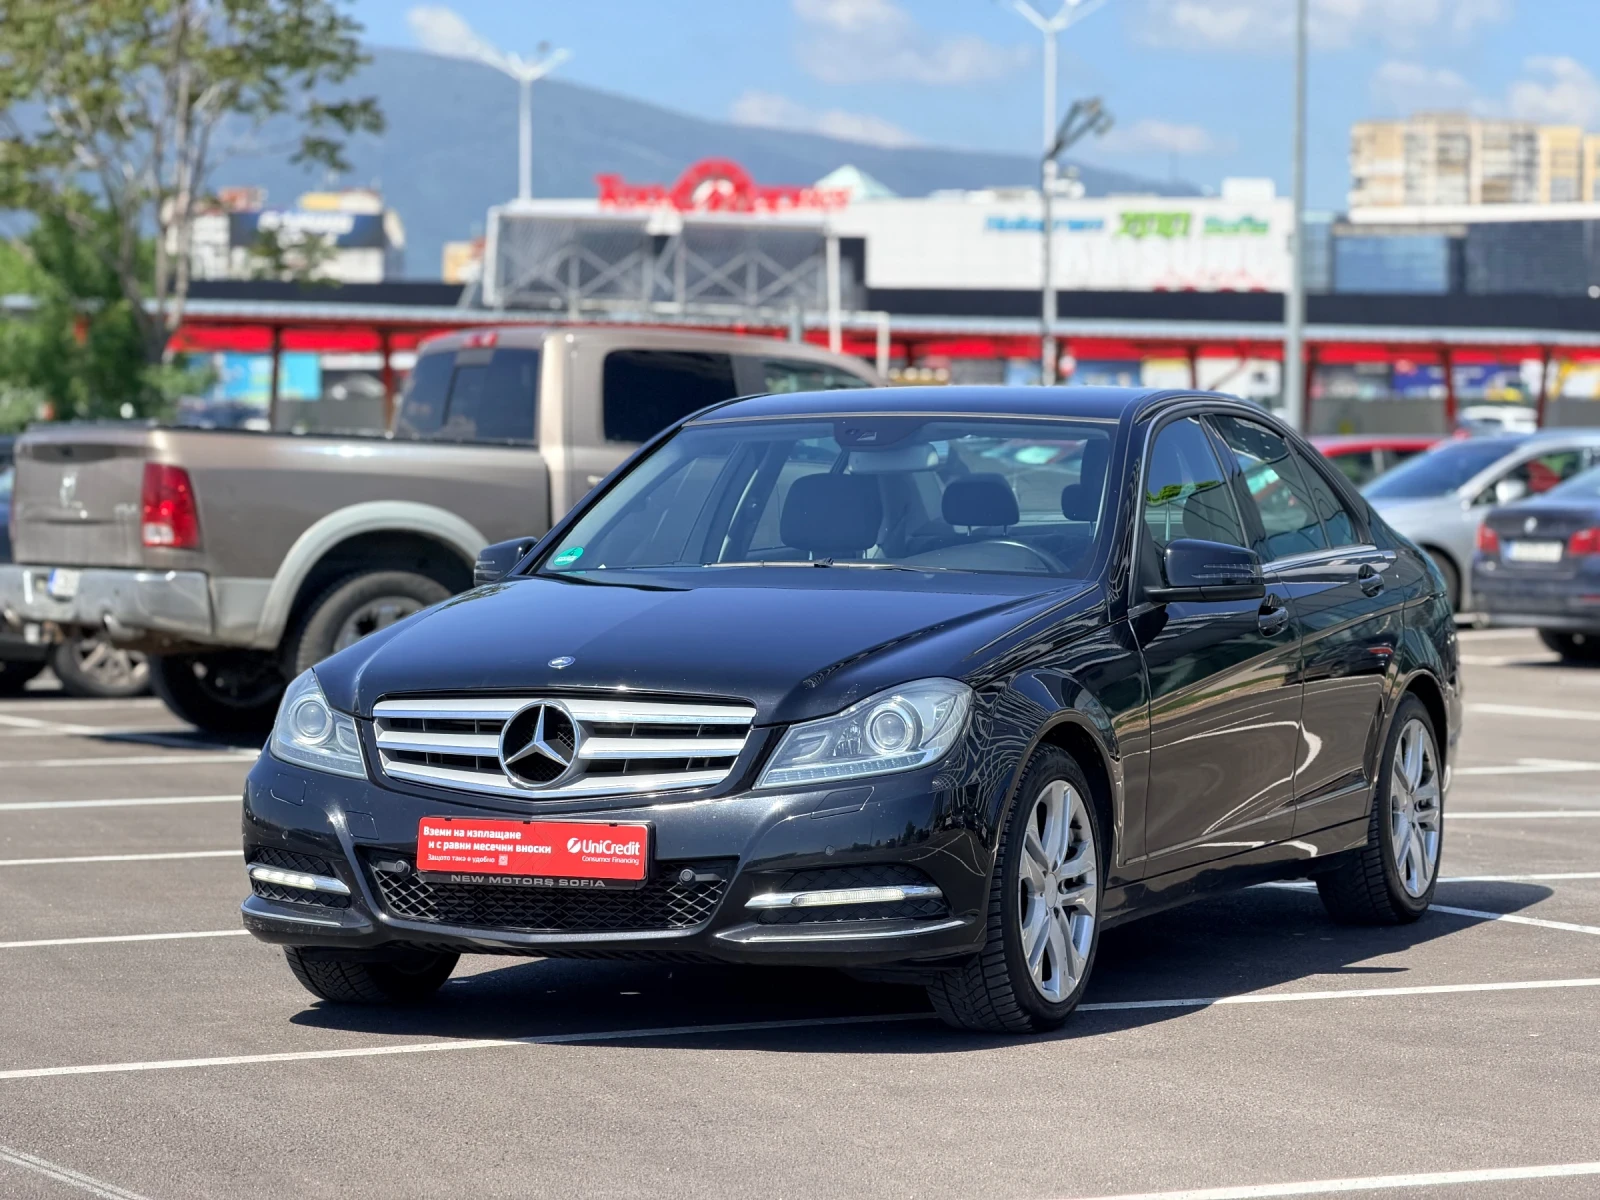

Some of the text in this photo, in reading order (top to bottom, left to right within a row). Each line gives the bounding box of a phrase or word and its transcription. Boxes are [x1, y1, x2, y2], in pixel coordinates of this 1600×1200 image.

[423, 826, 522, 840] Вземи на изплащане
[428, 841, 552, 854] и с равни месечни вноски
[582, 839, 641, 855] UniCredit
[427, 853, 451, 862] Защото
[581, 855, 640, 866] Consumer Financing
[450, 874, 606, 887] NEW MOTORS SOFIA
